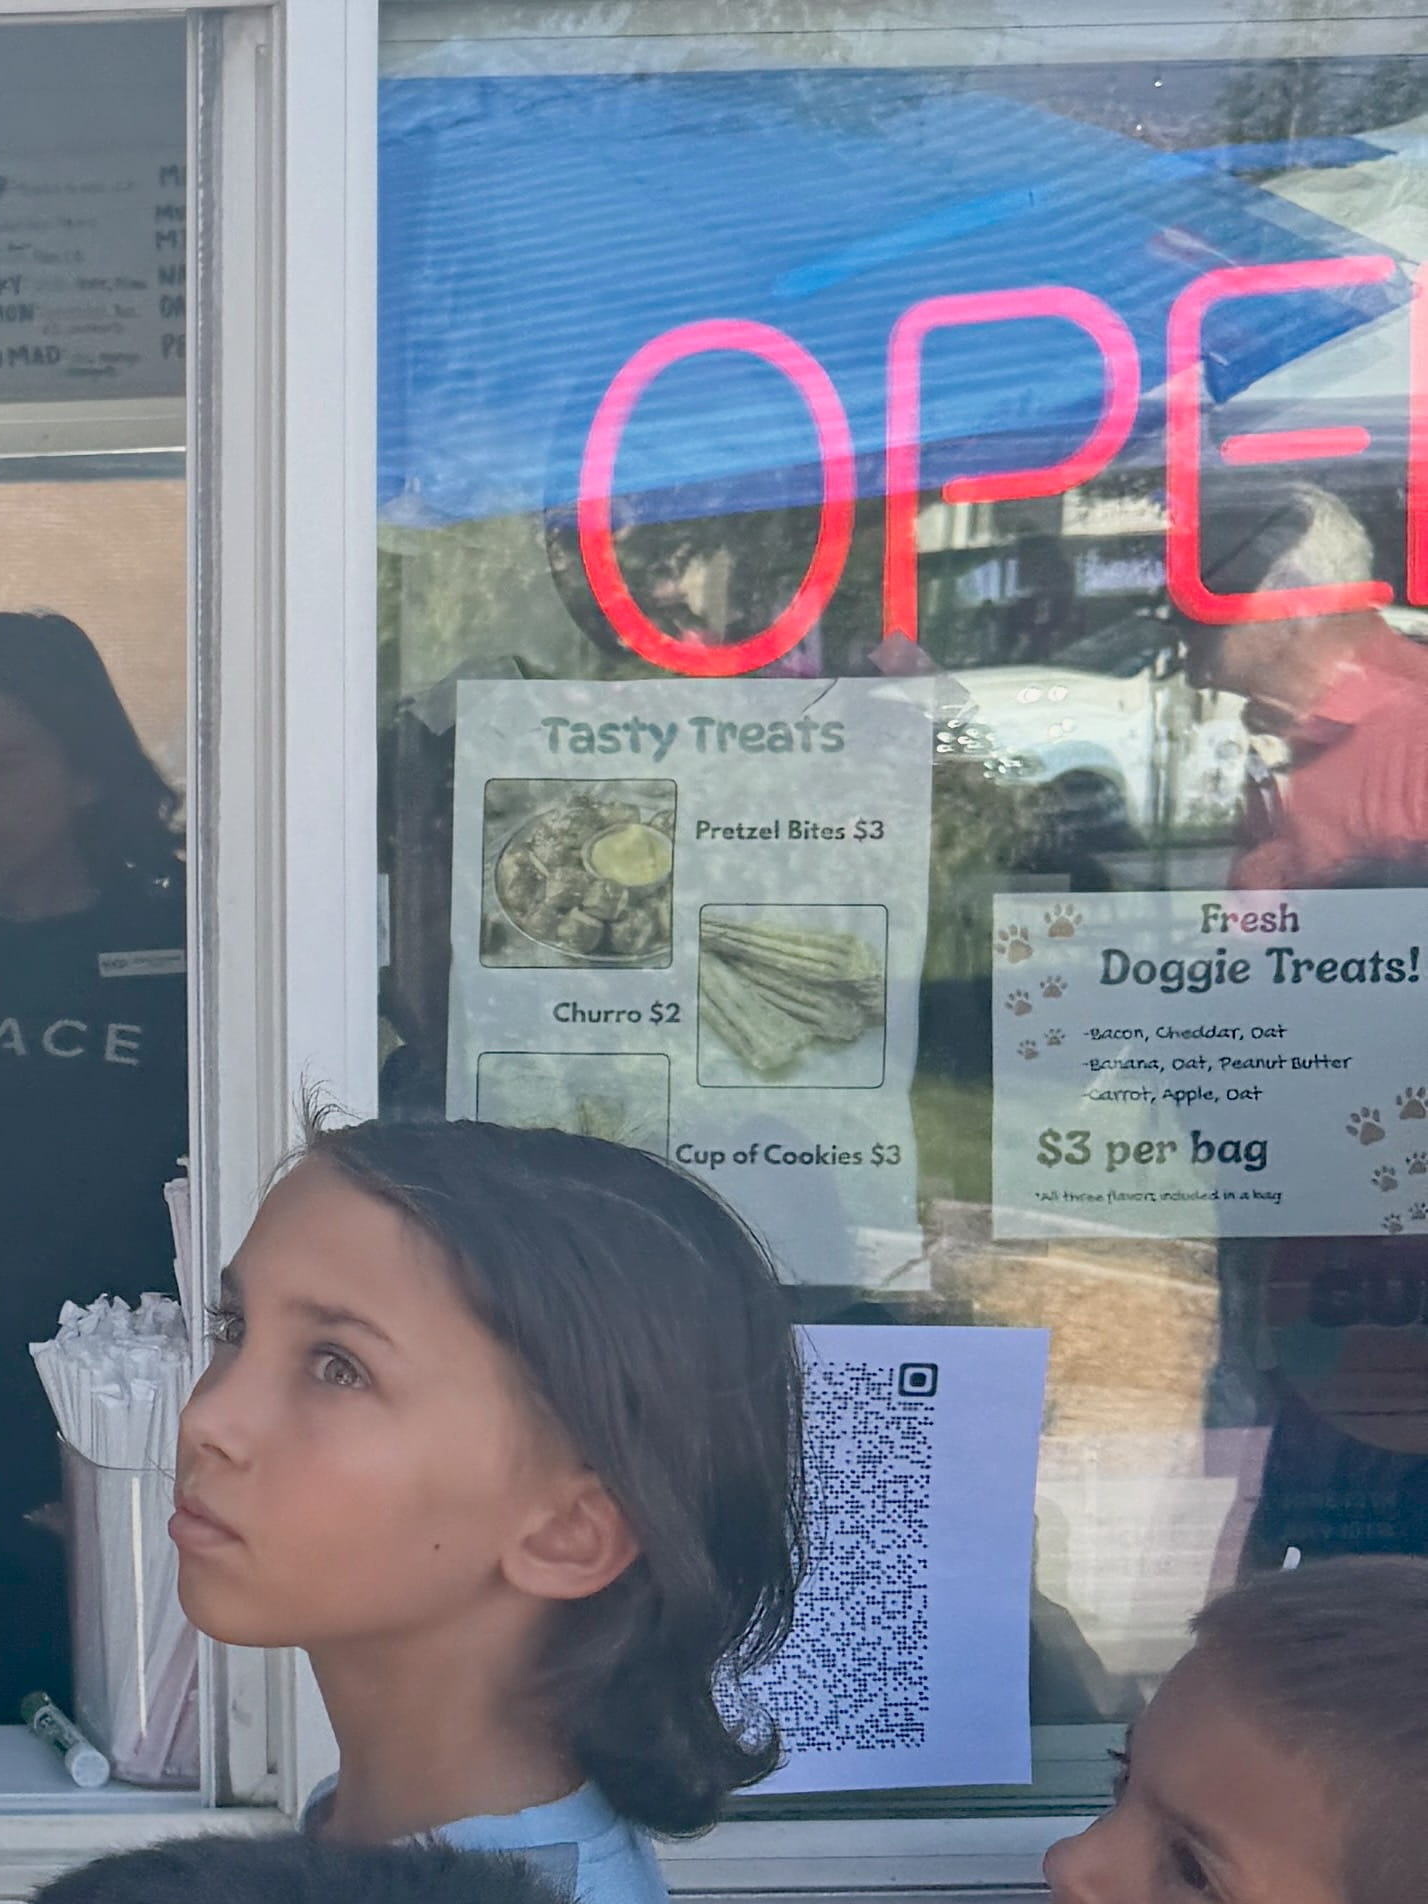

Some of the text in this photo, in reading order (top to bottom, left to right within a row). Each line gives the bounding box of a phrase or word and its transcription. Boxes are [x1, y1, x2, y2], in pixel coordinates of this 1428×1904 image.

[578, 254, 1428, 677] OPE
[542, 715, 845, 762] Tasty Treats
[695, 819, 885, 842] Pretzel Bites $3
[1201, 903, 1300, 934] Fresh
[1099, 946, 1422, 993] Doggie Treats!
[553, 1002, 681, 1025] Churro $2
[1251, 1026, 1287, 1039] Oat
[1219, 1056, 1287, 1070] Peanut
[1291, 1056, 1353, 1070] Butter
[1226, 1087, 1263, 1101] Oat
[676, 1143, 902, 1171] Cup of Cookies $3
[1037, 1128, 1268, 1172] $3 per bag
